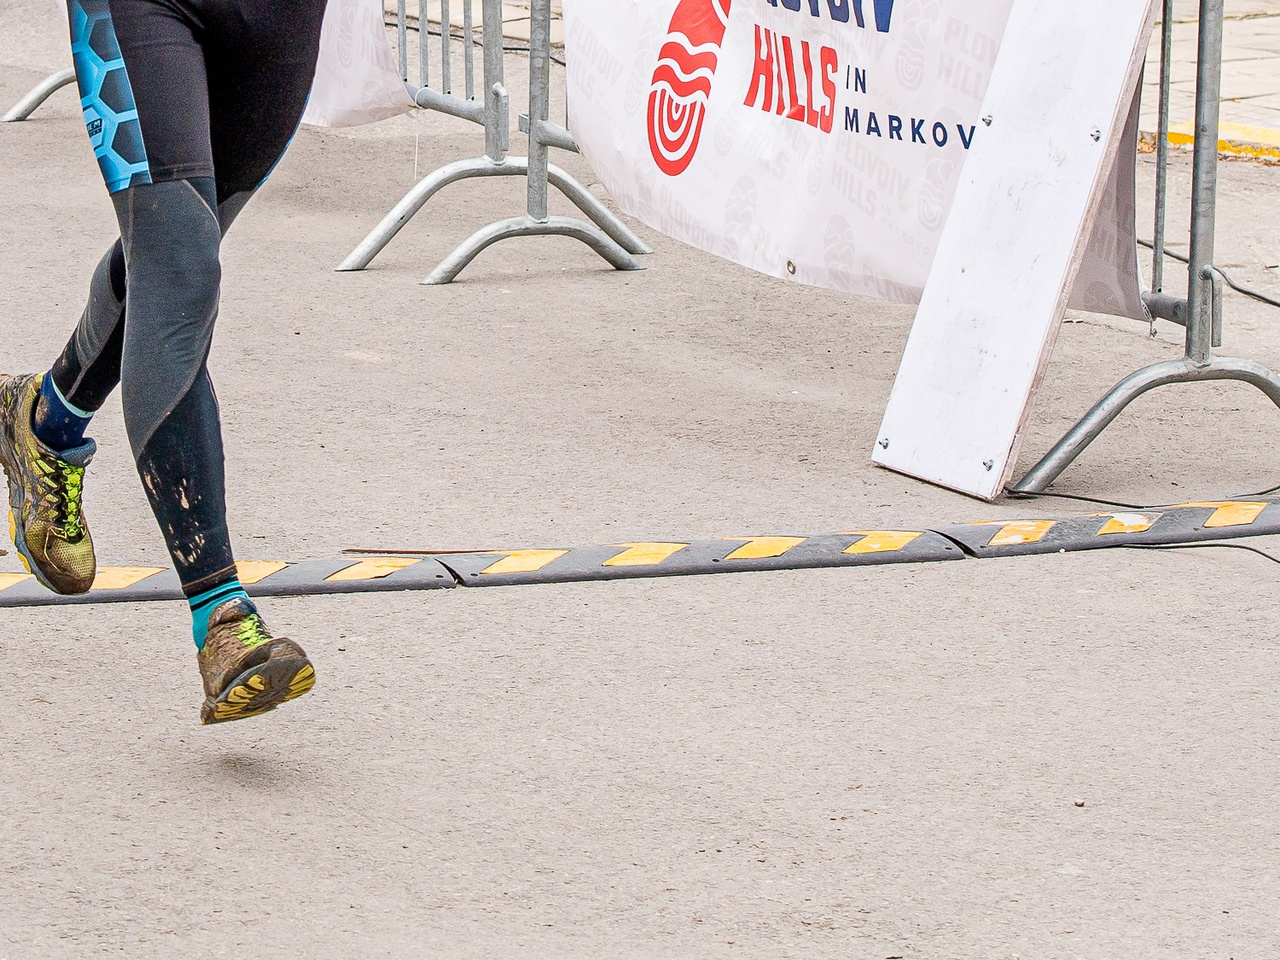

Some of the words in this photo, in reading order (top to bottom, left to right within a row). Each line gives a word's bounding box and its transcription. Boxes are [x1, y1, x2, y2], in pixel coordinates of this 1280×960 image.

[744, 25, 838, 134] HILLS
[845, 64, 867, 95] IN
[843, 105, 977, 151] MARKOV
